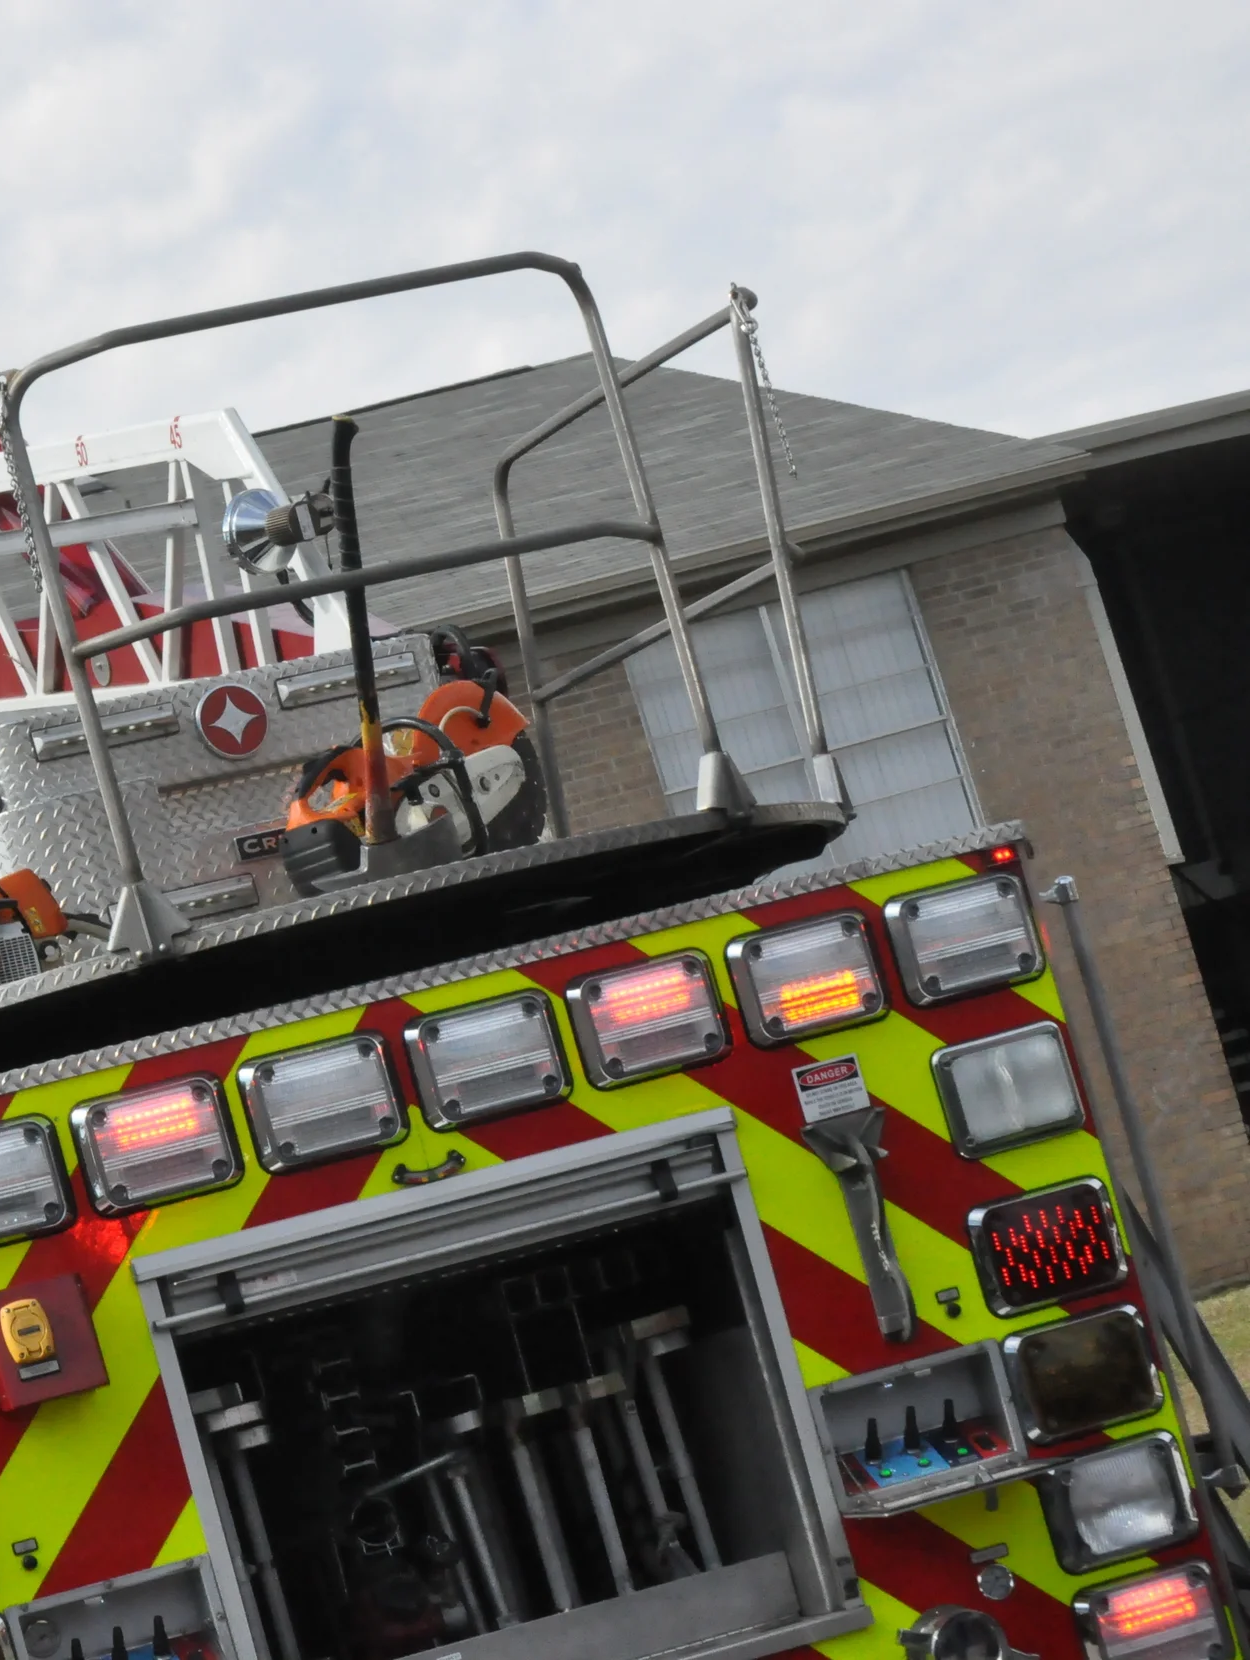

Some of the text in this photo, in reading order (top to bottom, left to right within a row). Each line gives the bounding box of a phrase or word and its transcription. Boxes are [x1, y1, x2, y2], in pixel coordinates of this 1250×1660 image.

[170, 424, 183, 449] 45
[75, 442, 88, 467] 50
[806, 1066, 848, 1084] DANGER
